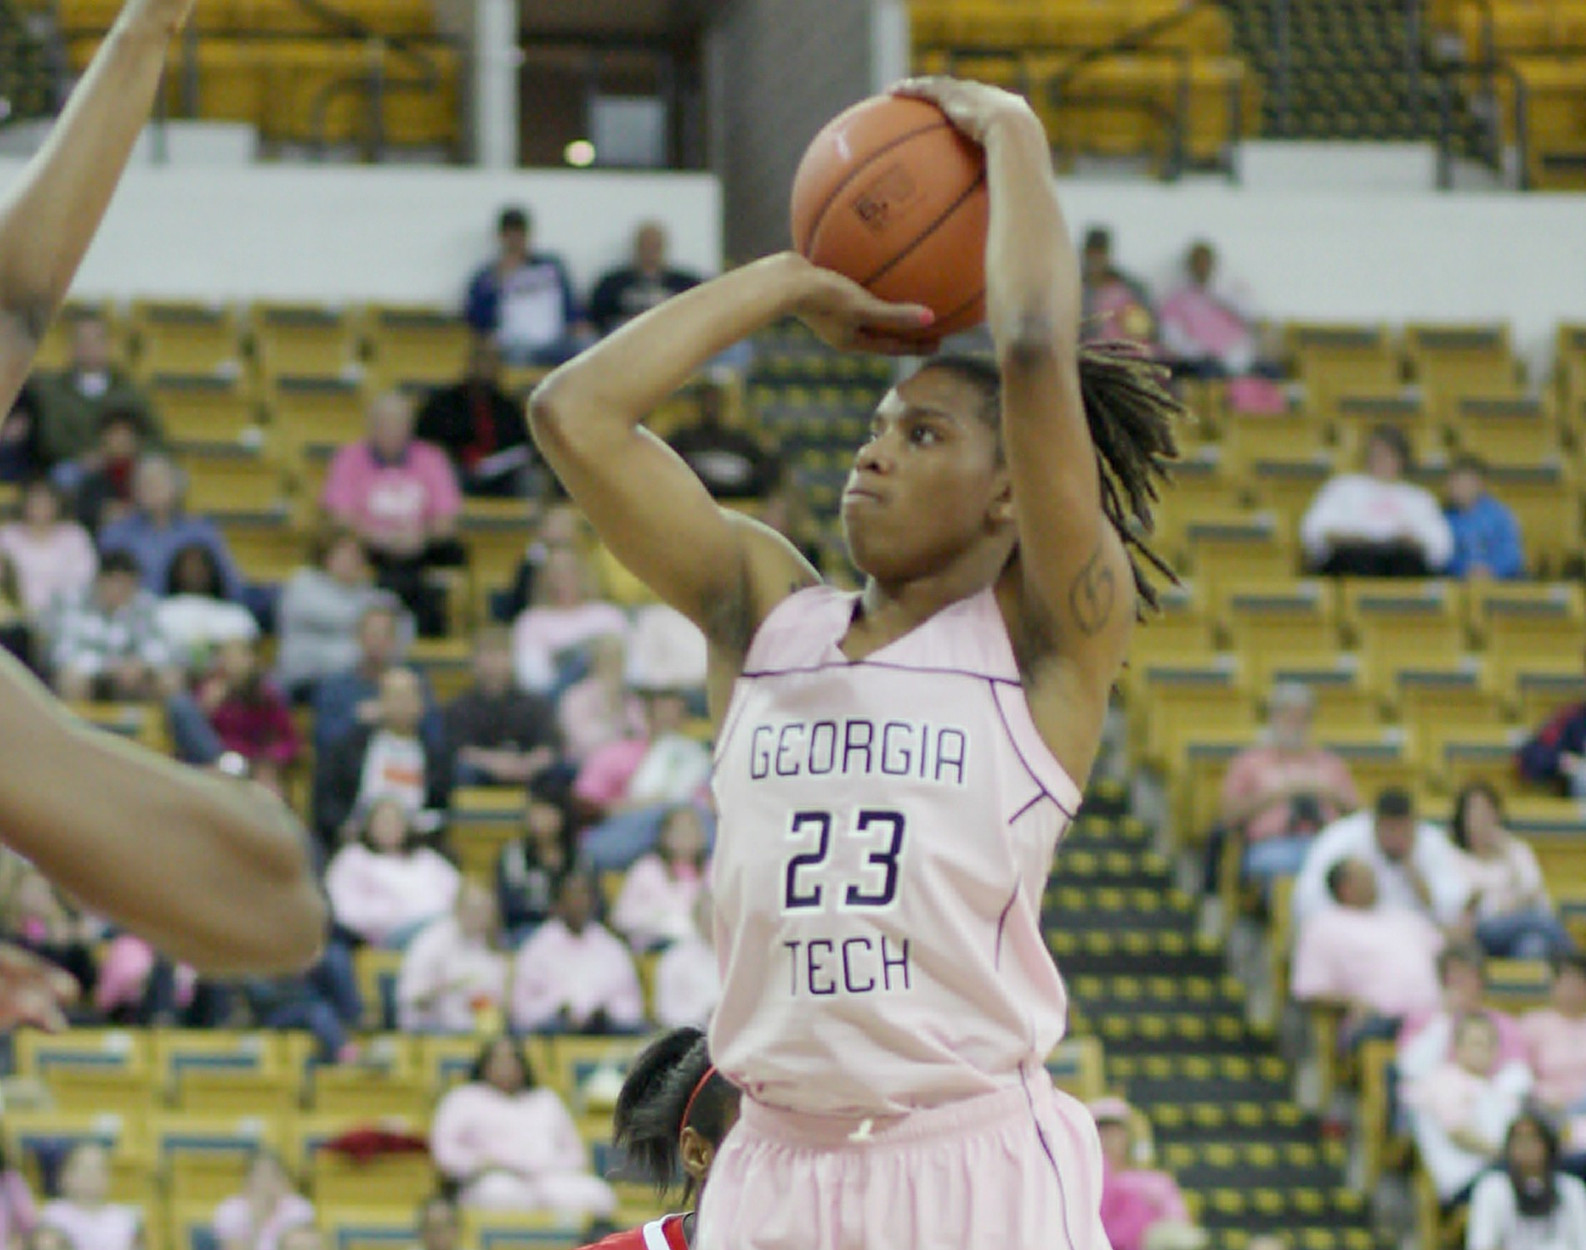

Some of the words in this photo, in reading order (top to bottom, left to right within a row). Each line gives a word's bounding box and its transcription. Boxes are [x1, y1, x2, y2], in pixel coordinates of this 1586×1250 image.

[750, 719, 966, 784] GEORGIA
[784, 810, 906, 909] 23
[783, 935, 910, 996] TECH
